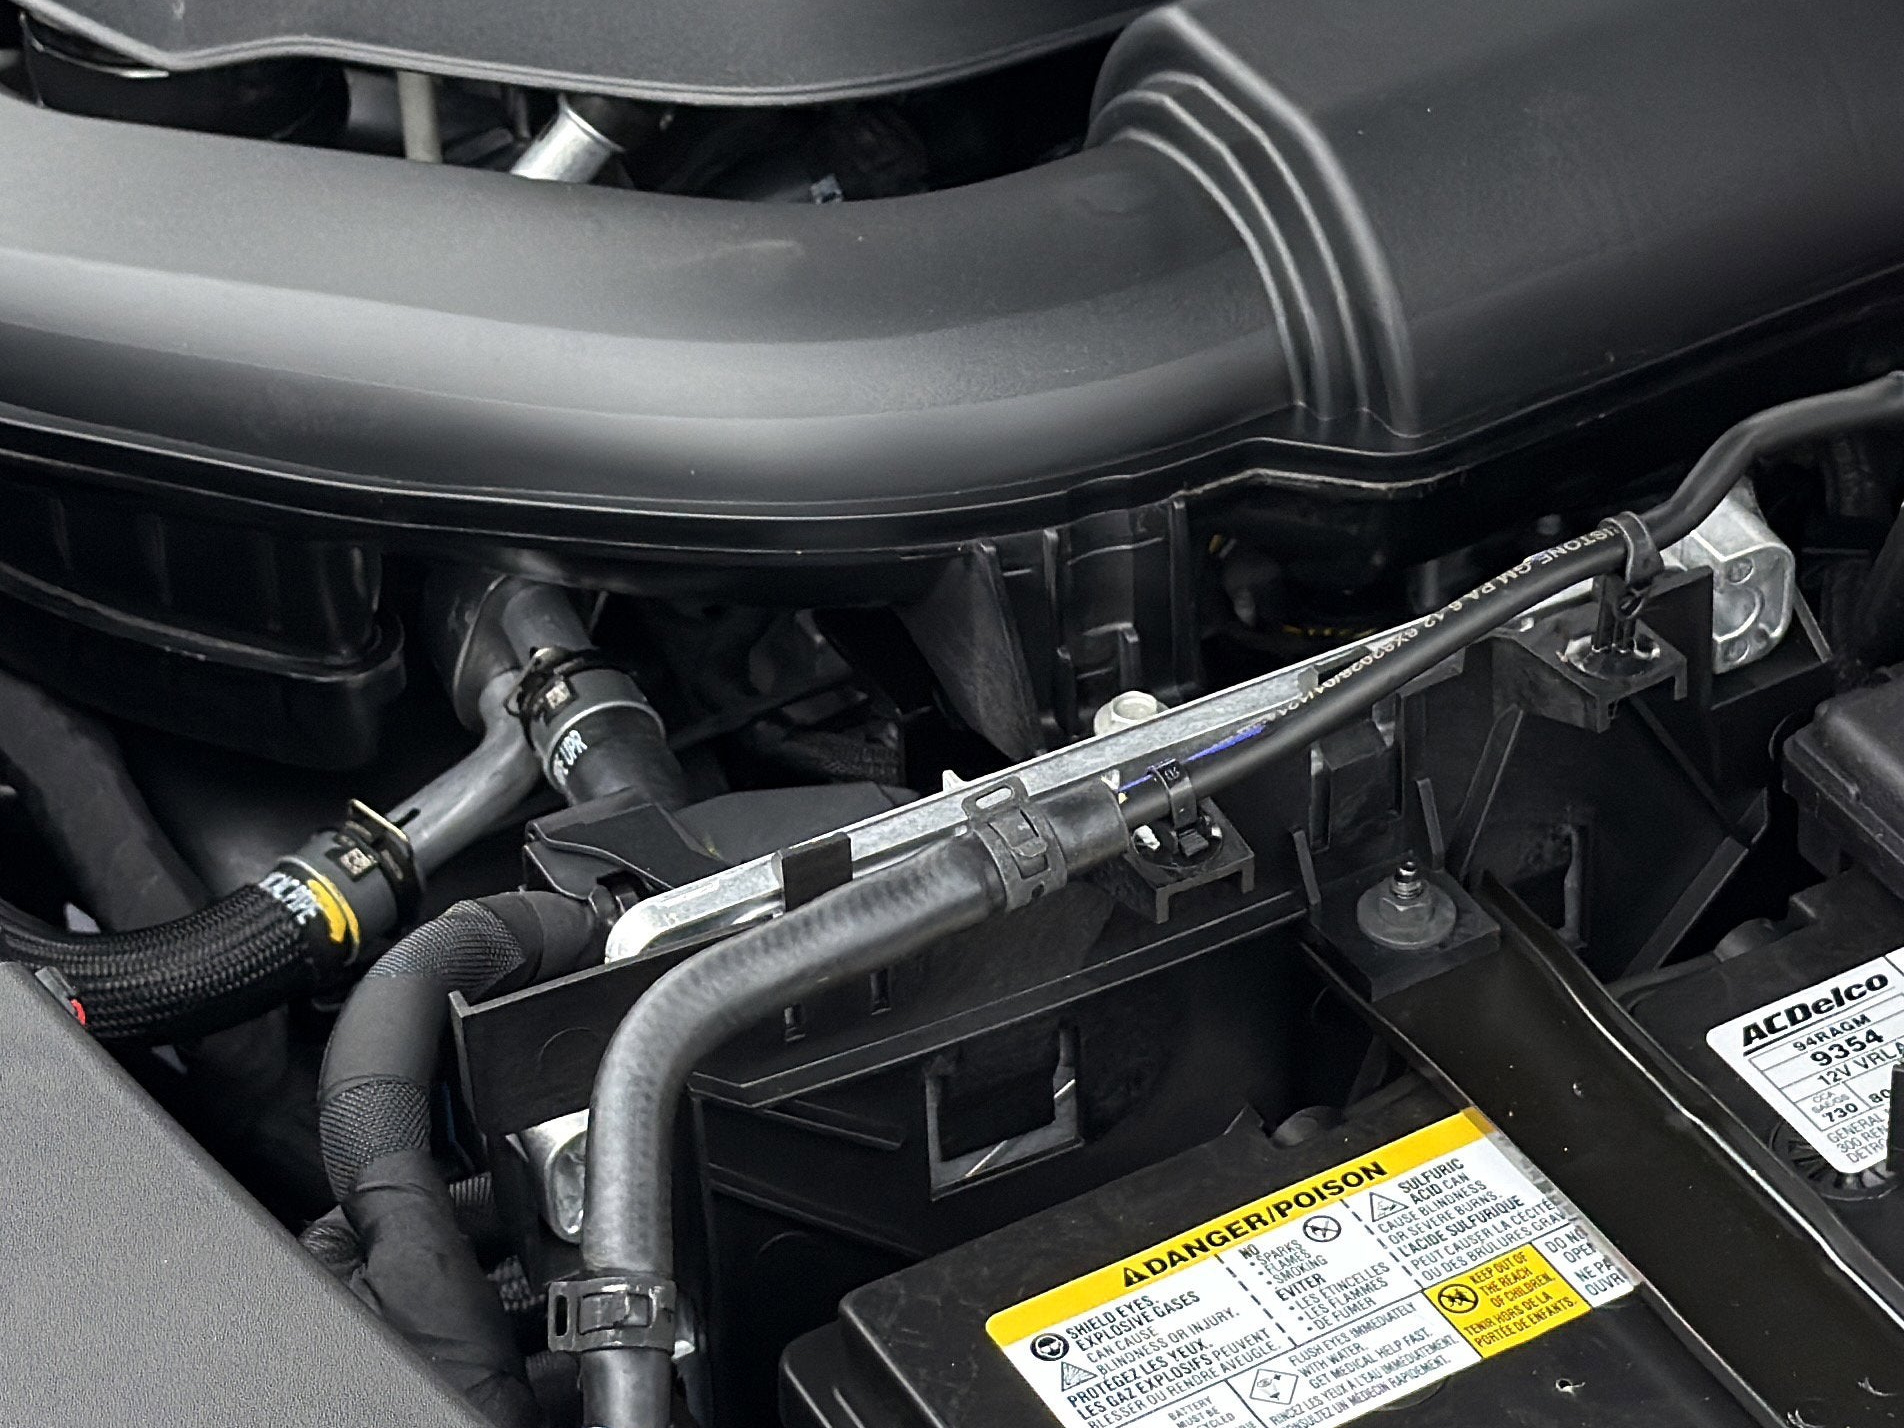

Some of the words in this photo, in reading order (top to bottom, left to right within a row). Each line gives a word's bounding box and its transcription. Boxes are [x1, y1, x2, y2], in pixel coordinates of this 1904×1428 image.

[1743, 974, 1888, 1047] ACDelco
[1793, 1014, 1871, 1051] 94RAGM
[1810, 1029, 1884, 1066] 9354
[1817, 1064, 1851, 1085] 12V
[1822, 1103, 1858, 1122] 730
[1826, 1113, 1885, 1143] GENERAL
[1398, 1158, 1464, 1194] SULFURIC
[1408, 1184, 1443, 1205] ACID
[1442, 1172, 1470, 1189] CAN
[1142, 1161, 1388, 1276] DANGER/POISON
[1377, 1211, 1420, 1233] CAUSE
[1417, 1180, 1487, 1216] BLINDNESS
[1388, 1231, 1409, 1244] OR
[1407, 1209, 1456, 1236] SEVERE
[1453, 1191, 1503, 1216] BURNS.
[1397, 1230, 1448, 1257] L'ACIDE
[1445, 1195, 1525, 1237] SULFURIQUE
[1254, 1239, 1302, 1265] SPARKS
[1263, 1248, 1311, 1275] FLAMES
[1410, 1249, 1444, 1270] PEUT
[1443, 1228, 1494, 1255] CAUSER
[1492, 1220, 1512, 1233] LA
[1544, 1237, 1567, 1253] DO
[1271, 1255, 1328, 1284] SMOKING
[1275, 1269, 1326, 1301] ÉVITER
[1421, 1266, 1442, 1281] OU
[1440, 1256, 1468, 1273] DES
[1468, 1267, 1494, 1285] KEEP
[1493, 1257, 1515, 1273] OUT
[1512, 1251, 1528, 1264] OF
[1478, 1281, 1502, 1296] THE
[1497, 1266, 1533, 1287] REACH
[1574, 1266, 1597, 1282] NE
[1295, 1293, 1320, 1310] LES
[1304, 1303, 1330, 1320] LES
[1326, 1277, 1388, 1309] FLAMMES
[1313, 1316, 1333, 1330] DE
[1331, 1297, 1377, 1322] FUMER
[1490, 1295, 1505, 1308] OF
[1521, 1298, 1539, 1311] DE
[1535, 1291, 1553, 1304] LA
[1066, 1312, 1116, 1339] SHIELD
[1115, 1295, 1159, 1318] EYES.
[1075, 1311, 1154, 1351] EXPLOSIVE
[1152, 1291, 1200, 1318] GASES
[1512, 1318, 1531, 1332] DE
[1086, 1345, 1116, 1363] CAN
[1114, 1326, 1159, 1351] CAUSE
[1096, 1338, 1168, 1375] BLINDNESS
[1167, 1329, 1189, 1343] OR
[1187, 1307, 1240, 1335] INJURY.
[1288, 1344, 1325, 1367] FLUSH
[1321, 1332, 1351, 1351] EYES
[1349, 1302, 1416, 1338] IMMEDIATELY
[1067, 1368, 1141, 1408] PROTÉGEZ
[1139, 1356, 1168, 1375] LES
[1166, 1338, 1213, 1362] YEUX.
[1077, 1401, 1107, 1420] LES
[1105, 1387, 1137, 1407] GAZ
[1135, 1354, 1213, 1394] EXPLOSIFS
[1211, 1328, 1270, 1361] PEUVENT
[1146, 1390, 1167, 1405] OU
[1166, 1367, 1220, 1396] RENDRE
[1220, 1341, 1281, 1374] AVEUGLE.
[1297, 1359, 1329, 1377] WITH
[1326, 1343, 1368, 1365] WATER.
[1309, 1373, 1331, 1389] GET
[1329, 1353, 1378, 1379] MEDICAL
[1374, 1340, 1402, 1359] HELP
[1402, 1327, 1433, 1347] FAST.
[1168, 1396, 1212, 1421] BATTERY
[1302, 1395, 1324, 1410] LES
[1320, 1383, 1349, 1401] YEUX
